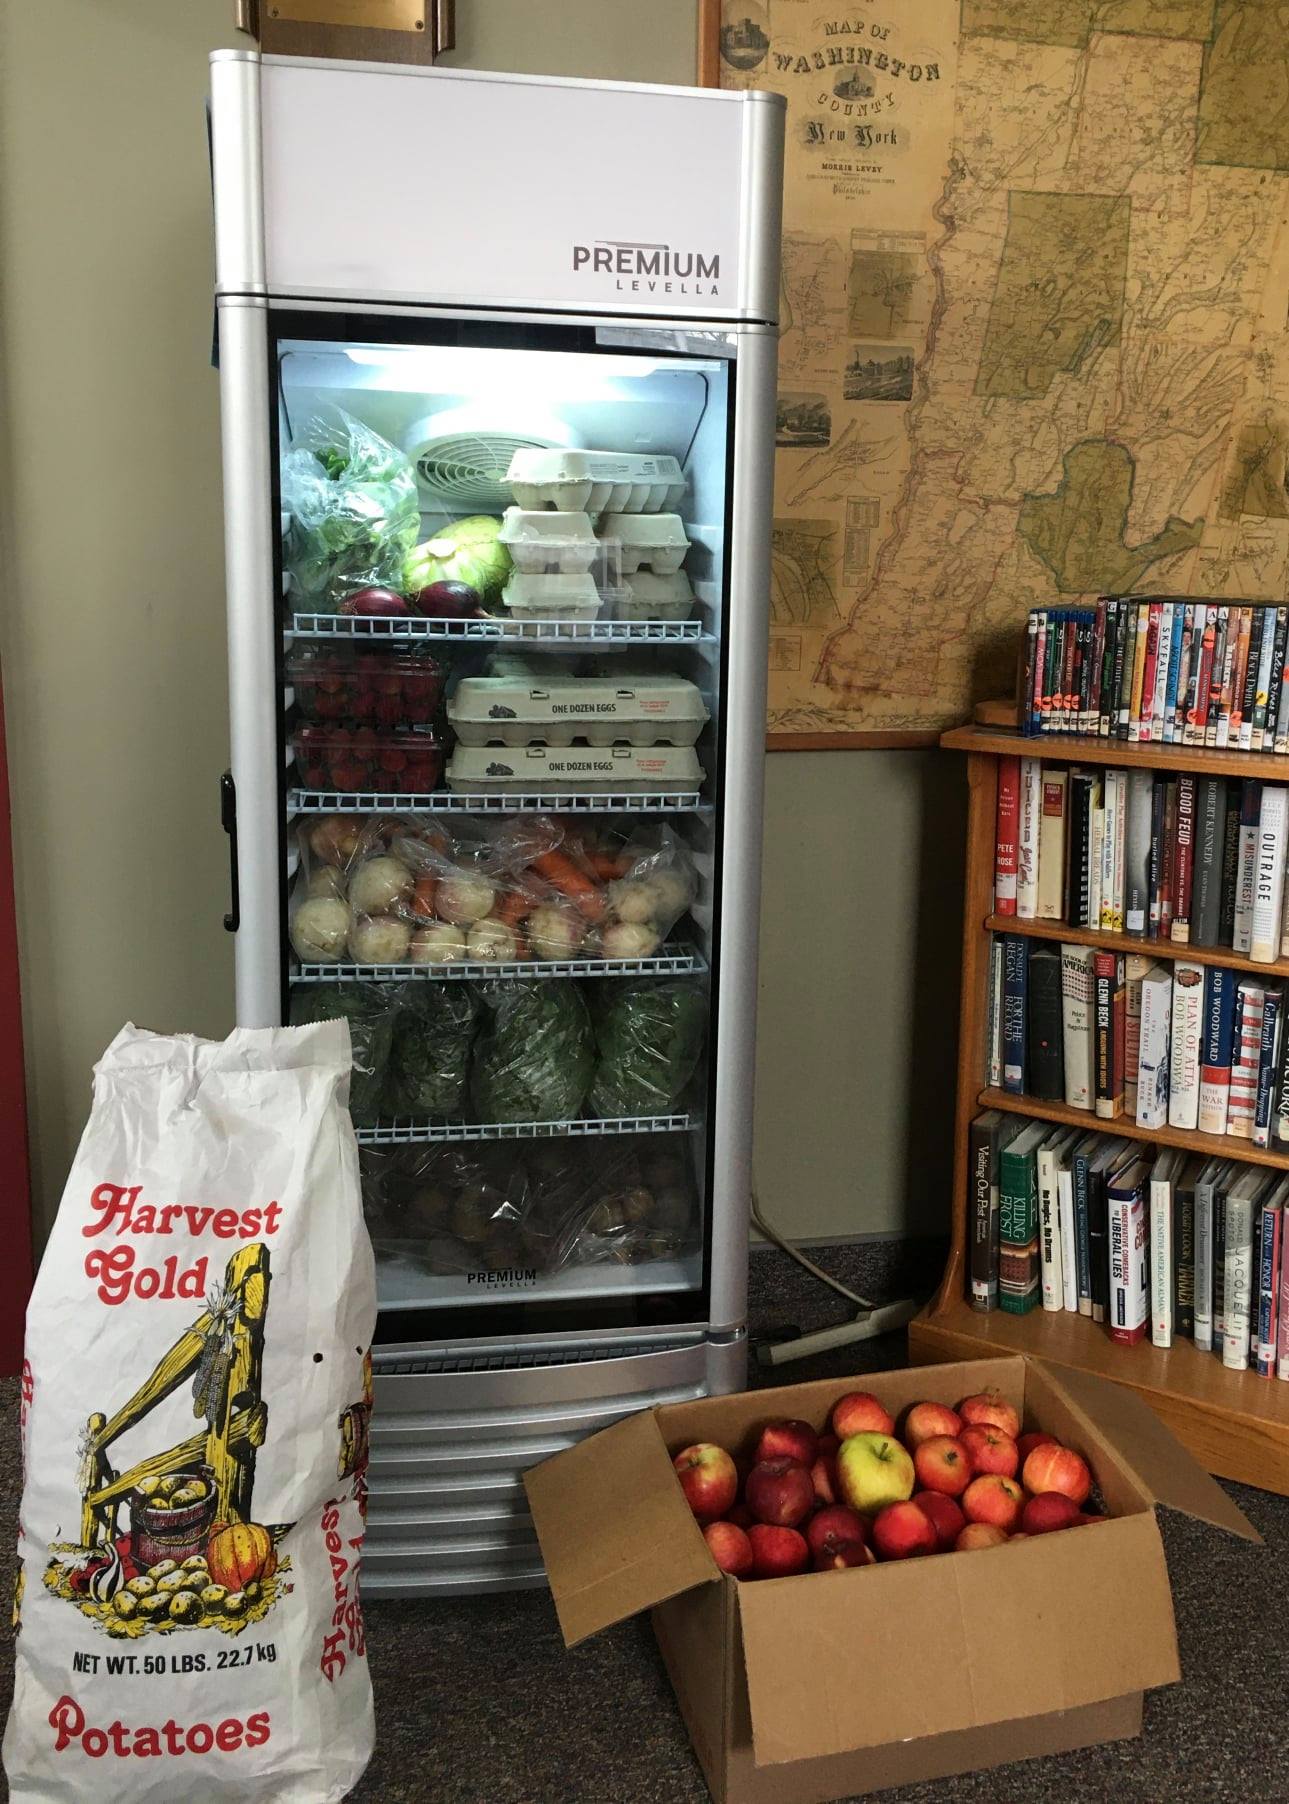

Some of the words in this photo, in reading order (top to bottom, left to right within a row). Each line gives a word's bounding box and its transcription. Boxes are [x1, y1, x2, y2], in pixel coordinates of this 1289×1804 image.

[824, 20, 864, 36] MAP
[871, 24, 890, 40] OF
[773, 47, 940, 82] WASHINGTON
[818, 92, 895, 116] COUNTY
[805, 121, 845, 145] New
[854, 125, 897, 149] York
[573, 246, 720, 279] PREMIUM
[617, 280, 719, 295] LEVELLA
[1158, 627, 1170, 683] SKYFALL
[552, 704, 568, 713] ONE
[570, 704, 595, 713] DOZEN
[597, 703, 616, 712] EGGS
[549, 762, 565, 771] ONE
[567, 762, 592, 771] DOZEN
[593, 762, 613, 770] EGGS
[1179, 779, 1193, 814] BLOOD
[1205, 782, 1217, 818] ROBERT
[1178, 817, 1191, 845] FEUD
[1203, 821, 1215, 865] KENNEDY
[997, 858, 1013, 866] ROSE
[998, 844, 1013, 853] PETE
[1242, 843, 1254, 904] MISUNDEREST
[1259, 833, 1275, 901] OUTRAGE
[1006, 942, 1016, 983] REGAN
[1098, 978, 1108, 1004] GLENN
[1213, 972, 1222, 993] BOB
[1004, 995, 1014, 1041] RECORD
[1013, 996, 1023, 1017] FOR
[1098, 1007, 1109, 1028] BECK
[1175, 995, 1185, 1020] BOB
[1187, 996, 1198, 1030] PLAN
[1013, 1019, 1023, 1042] THE
[1210, 997, 1221, 1062] WOODWARD
[1261, 1002, 1276, 1051] Galbraith
[1172, 1024, 1184, 1087] WOODWA
[1186, 1035, 1196, 1052] OF
[1185, 1056, 1195, 1088] ATTA
[1202, 1095, 1223, 1104] WAR
[1253, 1064, 1270, 1124] Name-Dropping
[975, 1145, 989, 1178] Visiting
[1076, 1159, 1084, 1188] GLENN
[977, 1180, 989, 1198] Our
[1042, 1190, 1050, 1199] No
[1077, 1190, 1085, 1210] BECK
[82, 1183, 283, 1239] Harvest
[977, 1199, 988, 1217] Past
[1000, 1194, 1012, 1237] FROST
[1013, 1197, 1025, 1238] KILLING
[1157, 1211, 1165, 1225] THE
[1182, 1202, 1193, 1231] ROBIN
[1044, 1228, 1051, 1236] No
[1112, 1217, 1121, 1255] LIBERAL
[1264, 1213, 1273, 1246] RETURN
[1182, 1234, 1192, 1260] COOK
[85, 1245, 208, 1305] Gold
[468, 1268, 536, 1283] PREMIUM
[1113, 1258, 1122, 1279] LIES
[1262, 1258, 1272, 1288] HONOR
[73, 1651, 100, 1674] NET
[106, 1656, 140, 1674] WT.
[144, 1655, 165, 1674] 50
[171, 1654, 211, 1674] LBS.
[216, 1646, 253, 1670] 22.7
[256, 1643, 276, 1662] kg
[49, 1695, 270, 1758] Potatoes
